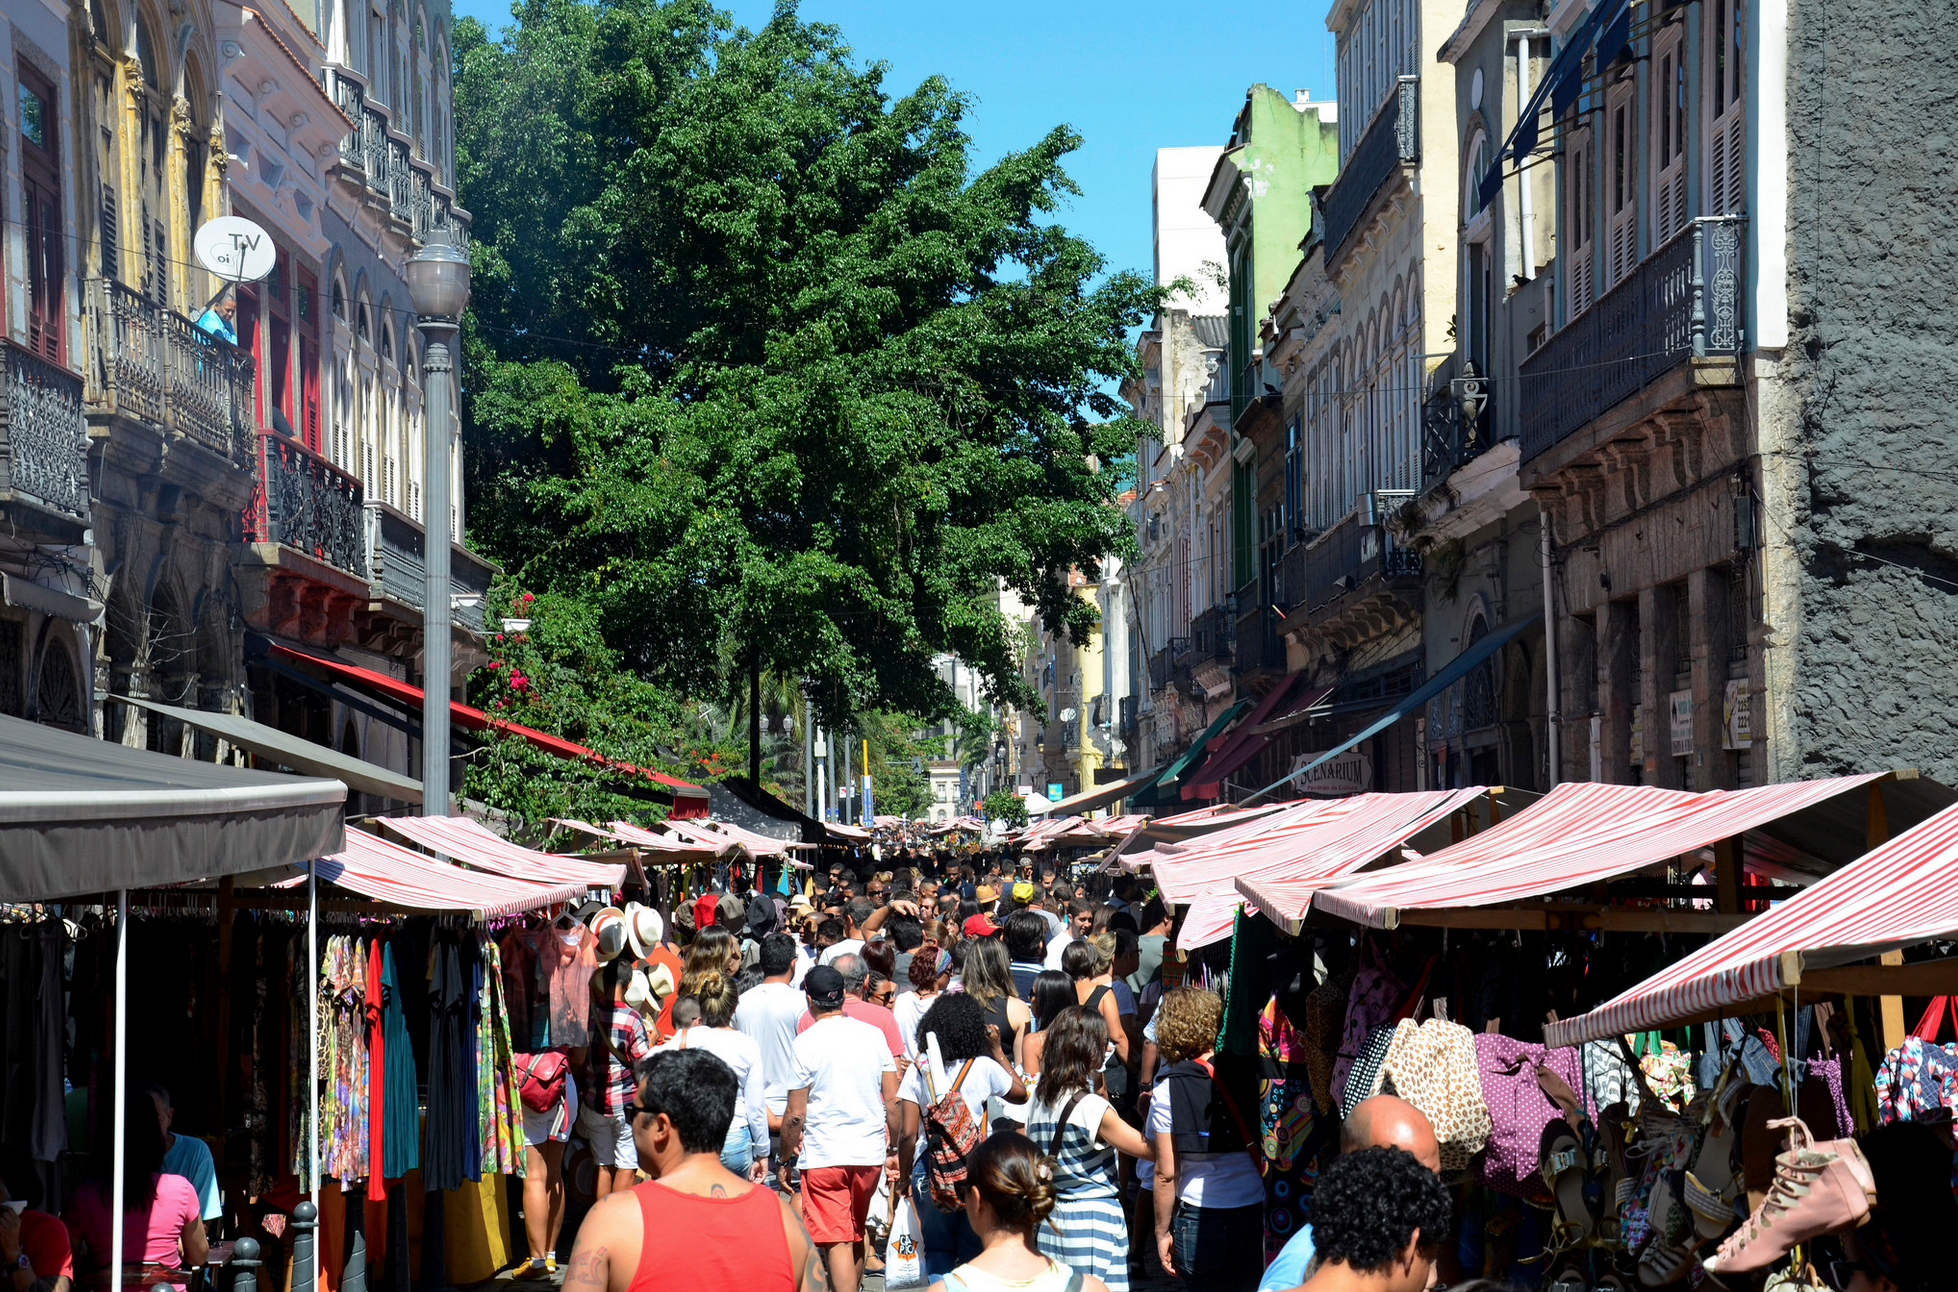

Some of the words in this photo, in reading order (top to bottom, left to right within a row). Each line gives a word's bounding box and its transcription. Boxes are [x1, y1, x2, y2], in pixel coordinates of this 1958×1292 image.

[228, 233, 260, 251] TV
[217, 253, 229, 263] oi
[1300, 759, 1362, 785] SCENARIUM
